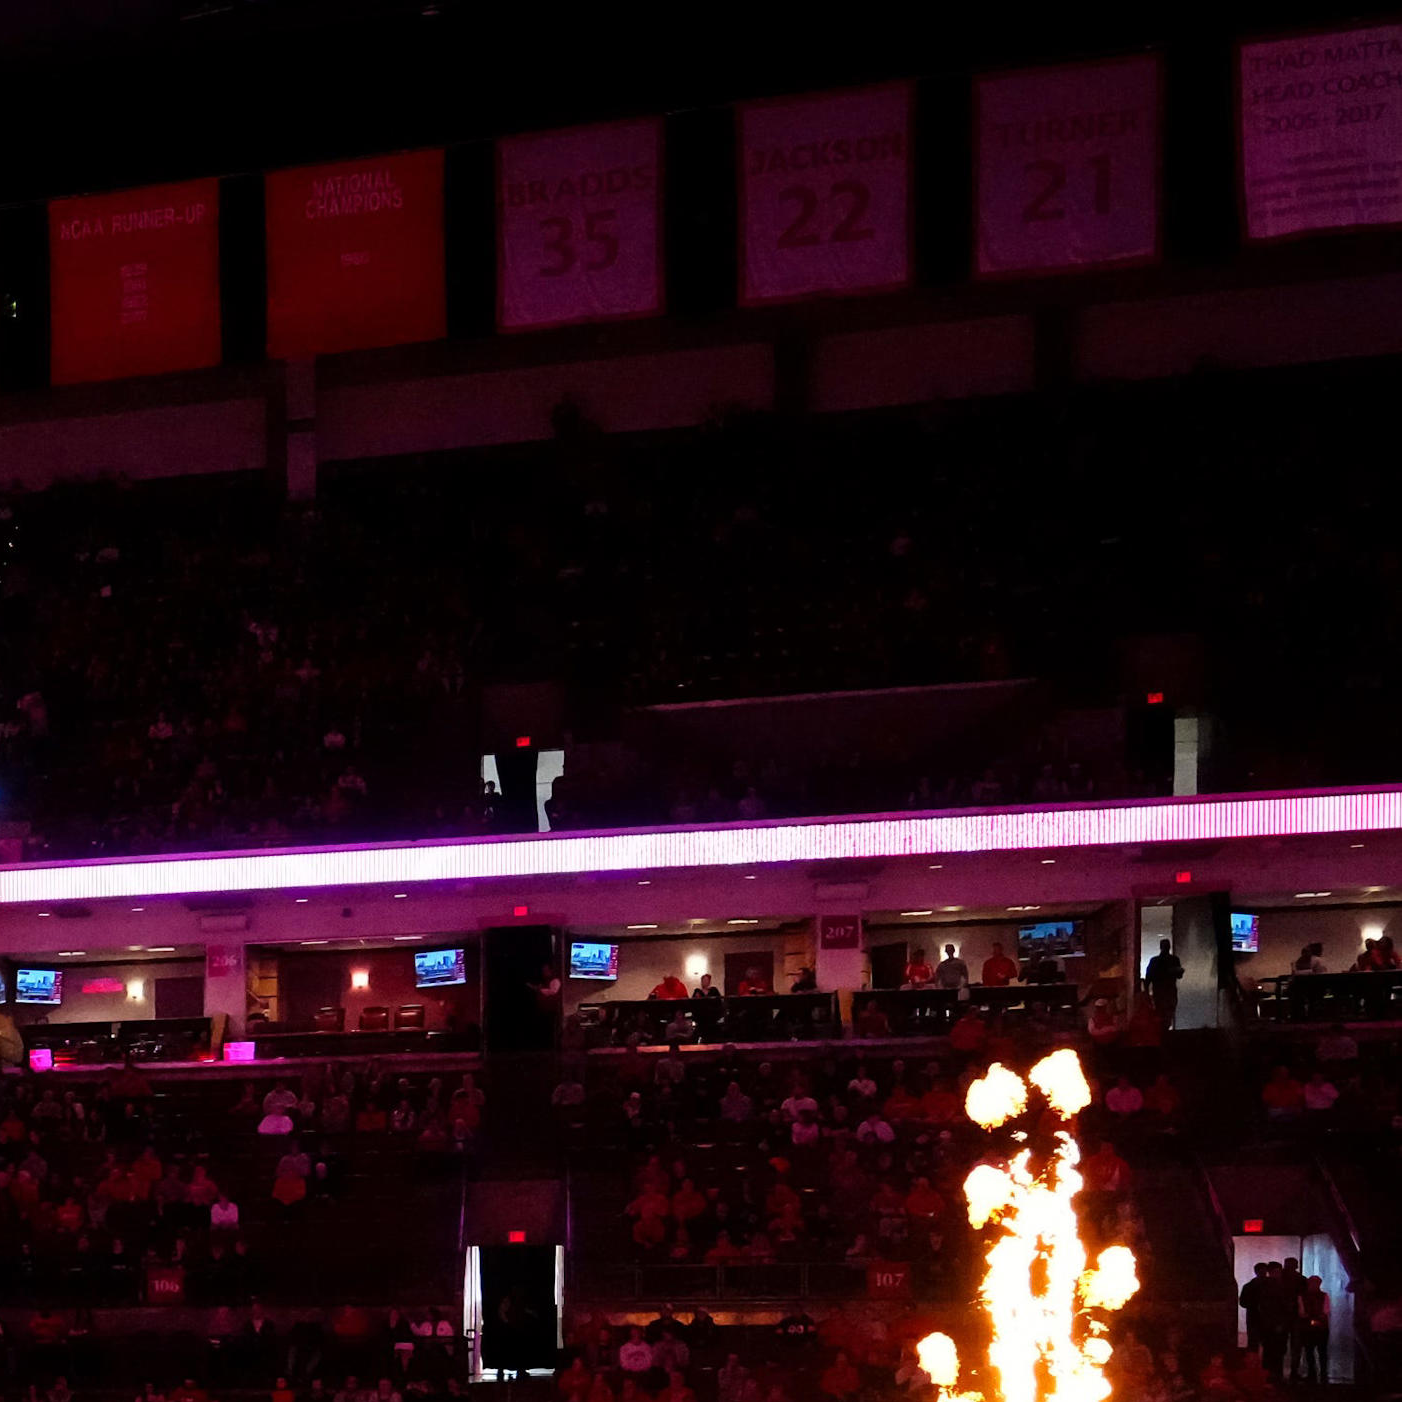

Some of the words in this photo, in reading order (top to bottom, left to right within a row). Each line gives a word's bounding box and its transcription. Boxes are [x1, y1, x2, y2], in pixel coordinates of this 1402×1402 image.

[993, 110, 1139, 148] TURNER
[750, 132, 903, 174] JACKSON
[503, 165, 653, 207] BRADDS
[1021, 154, 1111, 222] 21
[777, 179, 875, 248] 22
[539, 208, 620, 278] 35
[825, 925, 854, 940] 207
